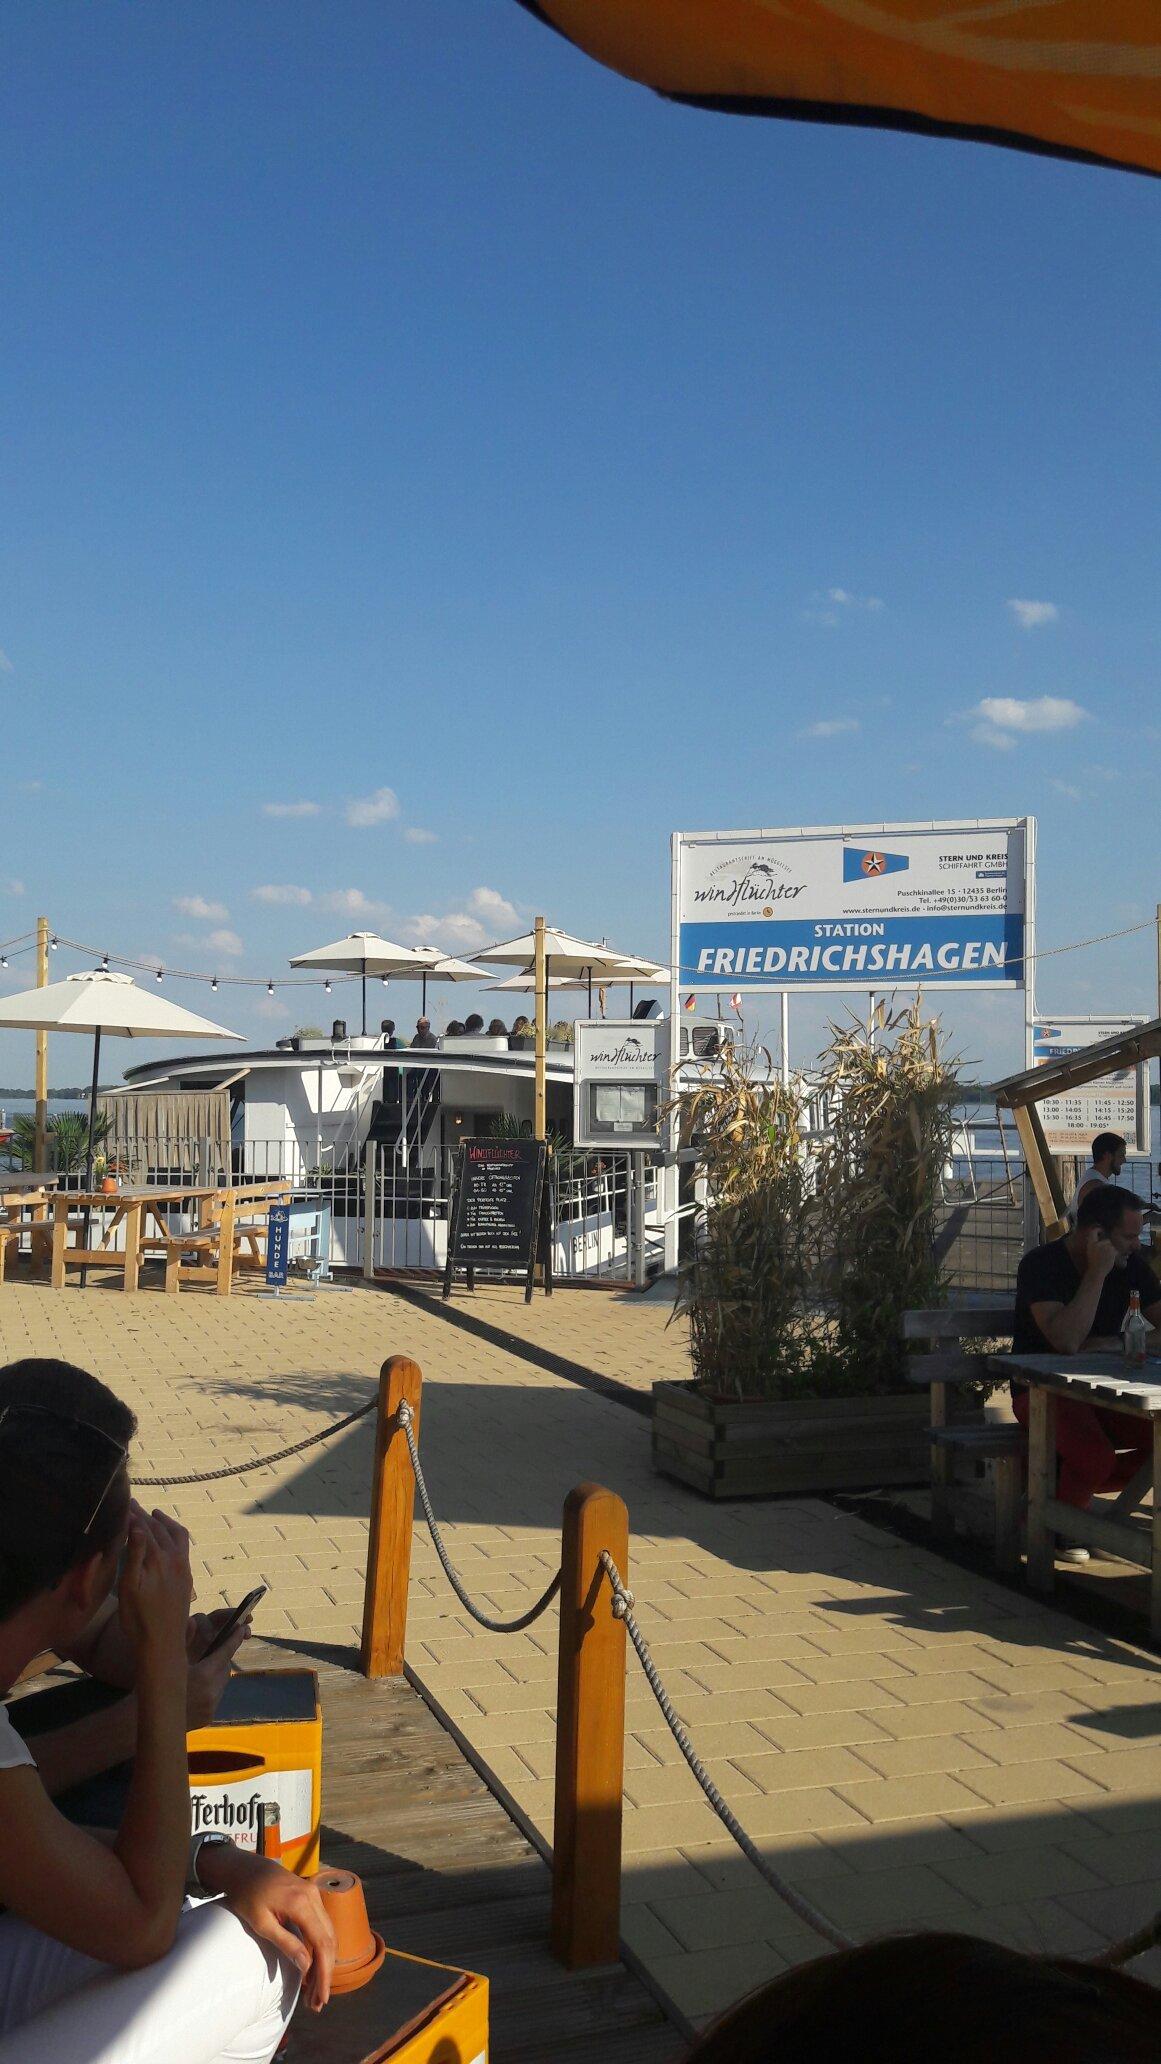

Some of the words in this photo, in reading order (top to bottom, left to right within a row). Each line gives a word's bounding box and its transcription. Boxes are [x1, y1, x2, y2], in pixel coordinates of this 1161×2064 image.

[939, 862, 982, 870] SCHIFFAHRT
[984, 861, 1009, 869] GMBH
[694, 877, 807, 907] windflüchter
[897, 889, 945, 897] Puschkinallee
[963, 887, 984, 895] 12435
[986, 886, 1008, 894] Berlin
[842, 905, 921, 914] www.sternundkreis.de
[926, 903, 1008, 912] info@sternundkreis.de
[814, 923, 884, 937] STATION
[697, 942, 1008, 973] FRIEDRICHSHAGEN
[590, 1047, 661, 1065] windflüchter
[274, 1227, 282, 1267] HUNDE
[573, 1231, 599, 1254] BERLIN
[192, 1792, 262, 1831] ferhof
